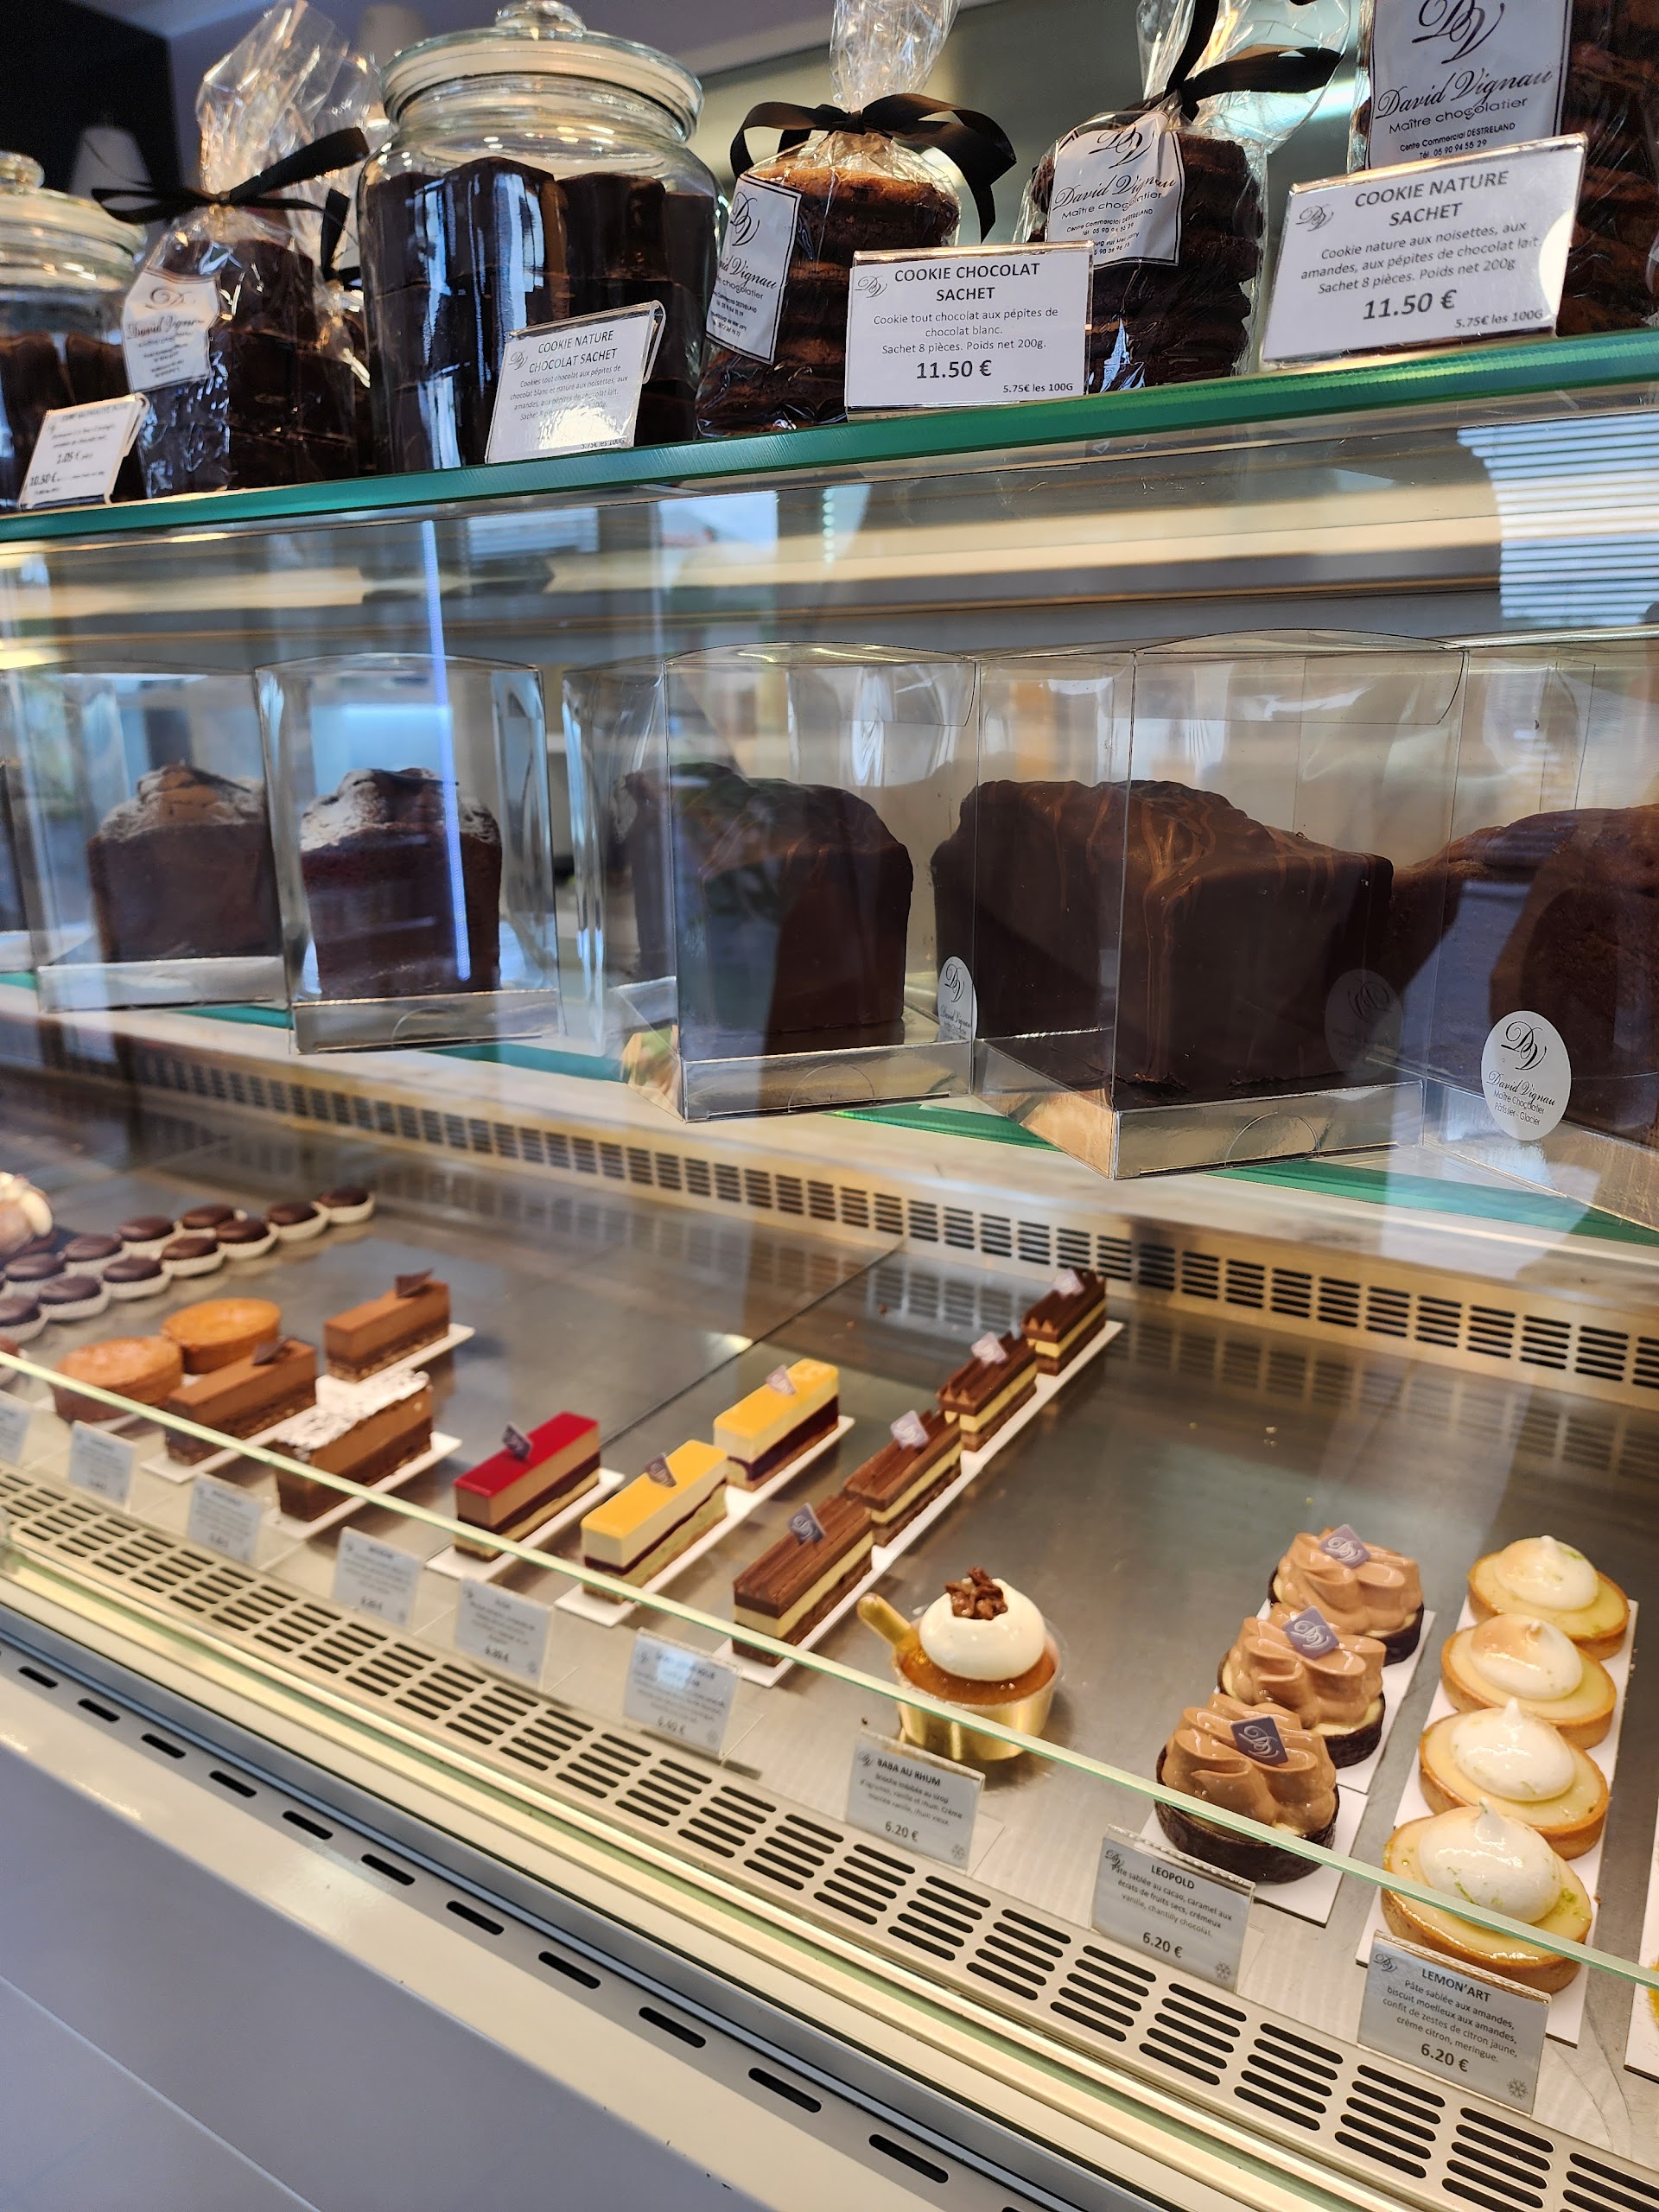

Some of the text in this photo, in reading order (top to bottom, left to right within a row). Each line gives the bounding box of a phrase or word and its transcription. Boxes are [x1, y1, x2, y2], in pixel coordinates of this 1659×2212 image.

[1376, 67, 1552, 119] David Vignau
[1389, 116, 1431, 134] Maître
[1400, 123, 1516, 152] Centre Commercial DESTRELAND
[1434, 148, 1443, 156] 05
[1445, 146, 1453, 155] 90
[1465, 142, 1474, 150] 55
[1478, 139, 1487, 149] 29
[1052, 175, 1117, 211] David
[1355, 170, 1510, 207] COOKIE NATURE
[1062, 204, 1095, 219] Maître
[1389, 202, 1463, 226] SACHET
[1321, 221, 1527, 259] Cookie nature aux noisettes, aux
[895, 263, 1040, 282] COOKIE CHOCOLAT
[1301, 264, 1358, 280] amandes,
[1362, 259, 1382, 271] aux
[1388, 251, 1433, 267] pépites
[1437, 248, 1453, 259] de
[1458, 240, 1513, 257] chocolat
[730, 257, 777, 289] Vignau
[1319, 280, 1358, 294] Sachet
[1362, 277, 1370, 288] 8
[1373, 271, 1415, 288] pièces.
[1420, 265, 1454, 280] Poids
[1458, 263, 1479, 275] net
[937, 287, 995, 302] SACHET
[1363, 289, 1458, 320] 11.50 €
[874, 308, 1058, 325] Cookie tout chocolat aux pépites de
[1455, 309, 1543, 329] 5.75€ les 100G
[538, 330, 614, 353] COOKIE NATURE
[925, 325, 1002, 337] chocolat blanc.
[882, 339, 1046, 354] Sachet 8 pièces. Poids net 200g.
[529, 348, 618, 373] CHOCOLAT SACHET
[917, 359, 992, 378] 11.50 €
[511, 390, 532, 401] chocolat
[588, 378, 616, 388] noisettes,
[520, 378, 541, 388] Cookies
[555, 372, 578, 382] chocolat
[591, 366, 613, 376] pépites
[1003, 385, 1030, 393] 5.75€
[1049, 383, 1073, 391] 100G
[1486, 1071, 1556, 1106] David Vignau
[1494, 1089, 1511, 1103] Maître
[1494, 1102, 1540, 1126] Pâtissier Glacier
[877, 1758, 940, 1787] BABA AU RHUM
[885, 1821, 918, 1841] 6.20 €
[1151, 1865, 1194, 1890] LEOPOLD
[1128, 1871, 1151, 1887] sablée
[1153, 1882, 1161, 1891] au
[1163, 1886, 1185, 1902] cacao,
[1187, 1897, 1217, 1914] caramel
[1218, 1909, 1232, 1921] aux
[1140, 1888, 1149, 1897] de
[1150, 1891, 1168, 1906] fruits
[1171, 1902, 1187, 1914] secs,
[1148, 1904, 1178, 1923] chantilly
[1142, 1931, 1183, 1958] 6.20 €
[1387, 1986, 1516, 2044] biscuit moelleux aux amandes,
[1405, 1980, 1515, 2030] Pâte sablée aux amandes,
[1382, 1998, 1517, 2057] confit de zestes de citron jaune,
[1396, 2016, 1498, 2063] crème citron, meringue.
[1421, 2043, 1469, 2072] 6.20 €
